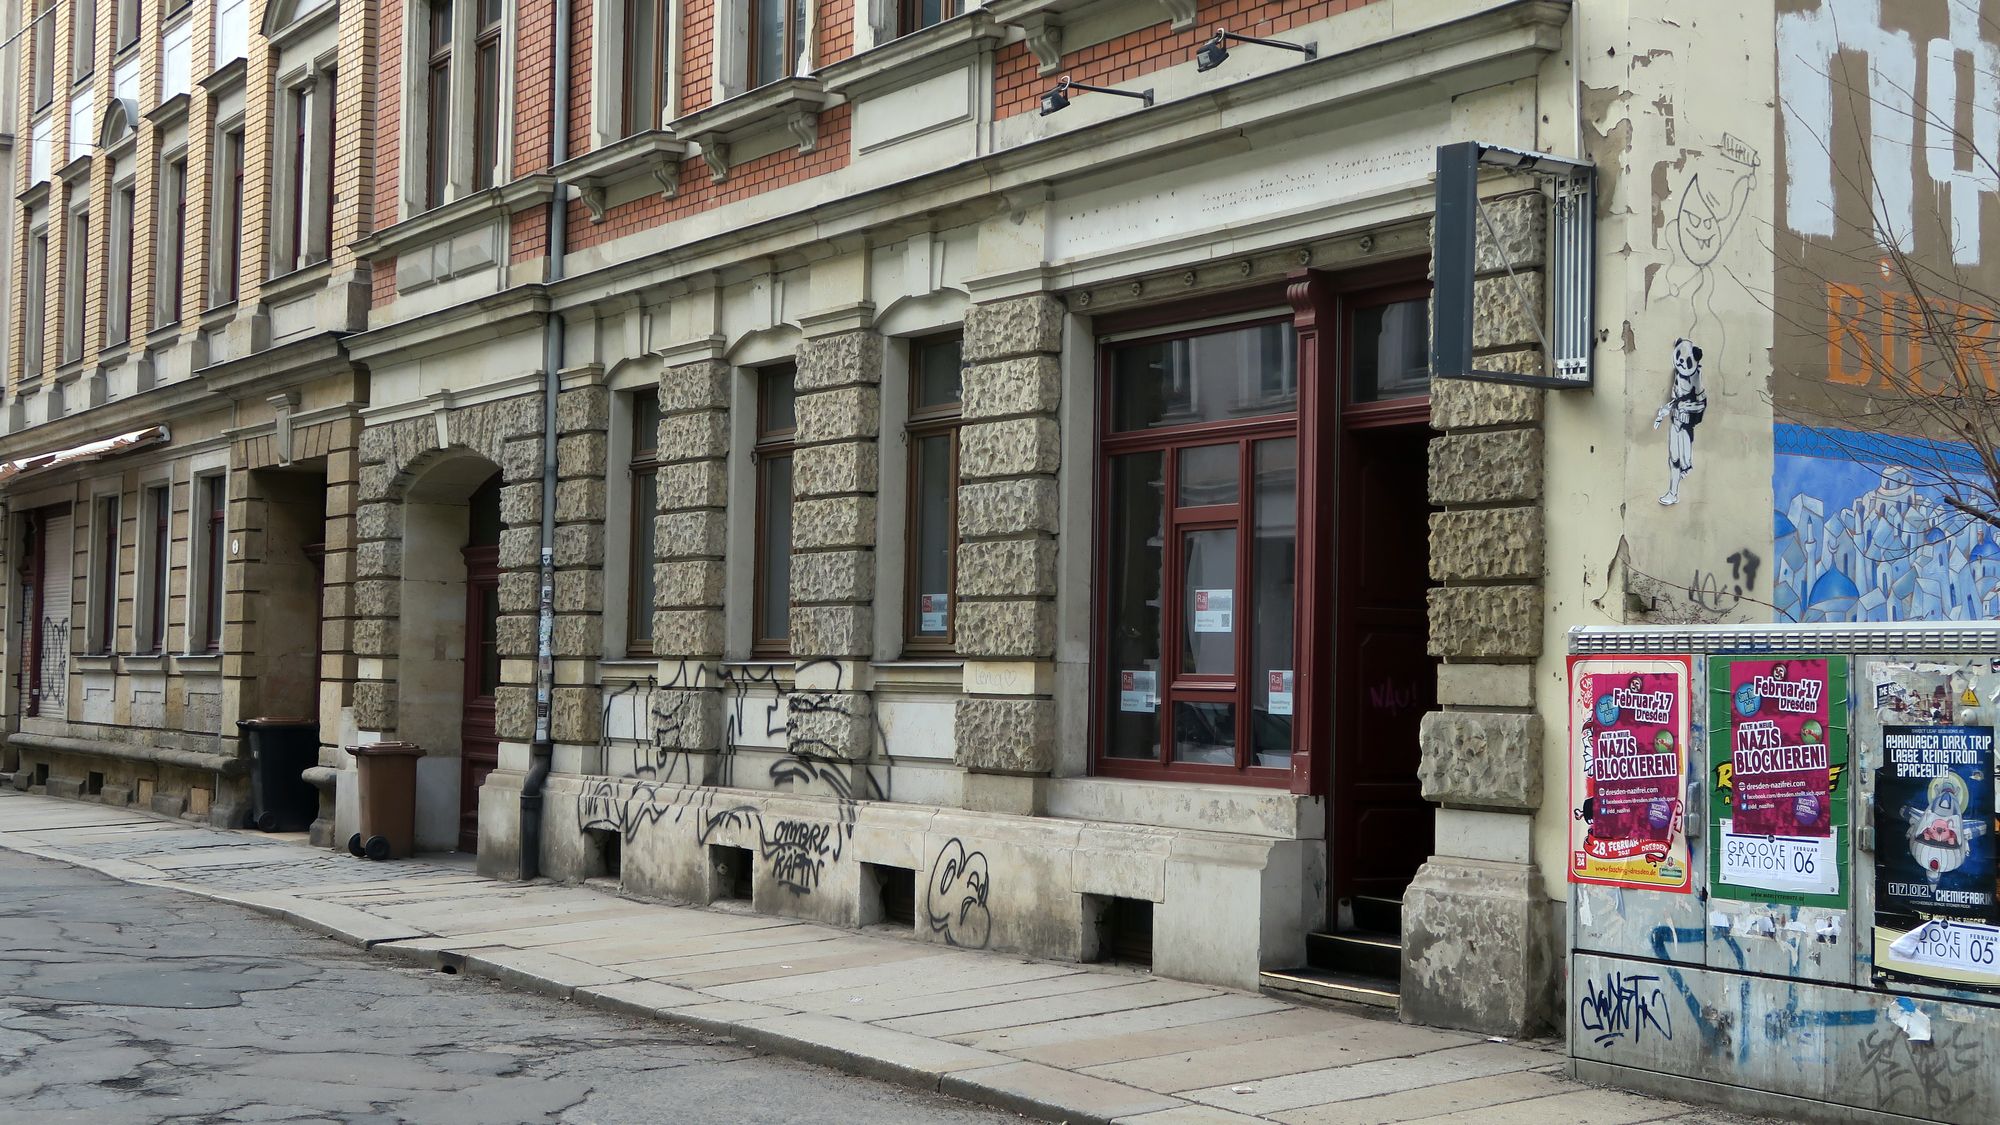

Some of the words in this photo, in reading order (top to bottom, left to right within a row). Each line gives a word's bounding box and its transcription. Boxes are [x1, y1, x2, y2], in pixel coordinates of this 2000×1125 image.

[1754, 676, 1800, 698] Februar
[1613, 689, 1653, 710] Februar
[1779, 697, 1816, 712] Dresden
[1635, 708, 1668, 723] Dresden
[1738, 728, 1780, 751] NAZIS
[1886, 734, 1939, 749] AYAHUASCA
[1942, 735, 1968, 750] DARK
[1969, 736, 1992, 750] TRIP
[1599, 738, 1636, 759] NAZIS
[1891, 749, 1919, 763] LASSE
[1596, 754, 1677, 780] BLOCKIEREN!
[1734, 745, 1826, 774] BLOCKIEREN!
[1897, 764, 1949, 778] SPACESLUG
[1605, 787, 1659, 796] dresden-nazifrei.com
[1746, 780, 1806, 790] dresden-nazifrei.com
[1747, 790, 1826, 799] facebook.com/dresden.stellt.sich.quer
[1592, 839, 1607, 856] 28.
[1727, 841, 1786, 858] GROOVE
[1793, 845, 1818, 853] FEBRUAR
[1577, 858, 1585, 867] 24
[1727, 853, 1786, 871] STATION
[1794, 851, 1814, 874] 06
[1888, 882, 1931, 898] 17.02.
[1935, 889, 1993, 905] CHEMIEFABRIK
[1969, 933, 1999, 943] FEBRUAR
[1911, 941, 1961, 959] ATION
[1970, 939, 1995, 965] 05
